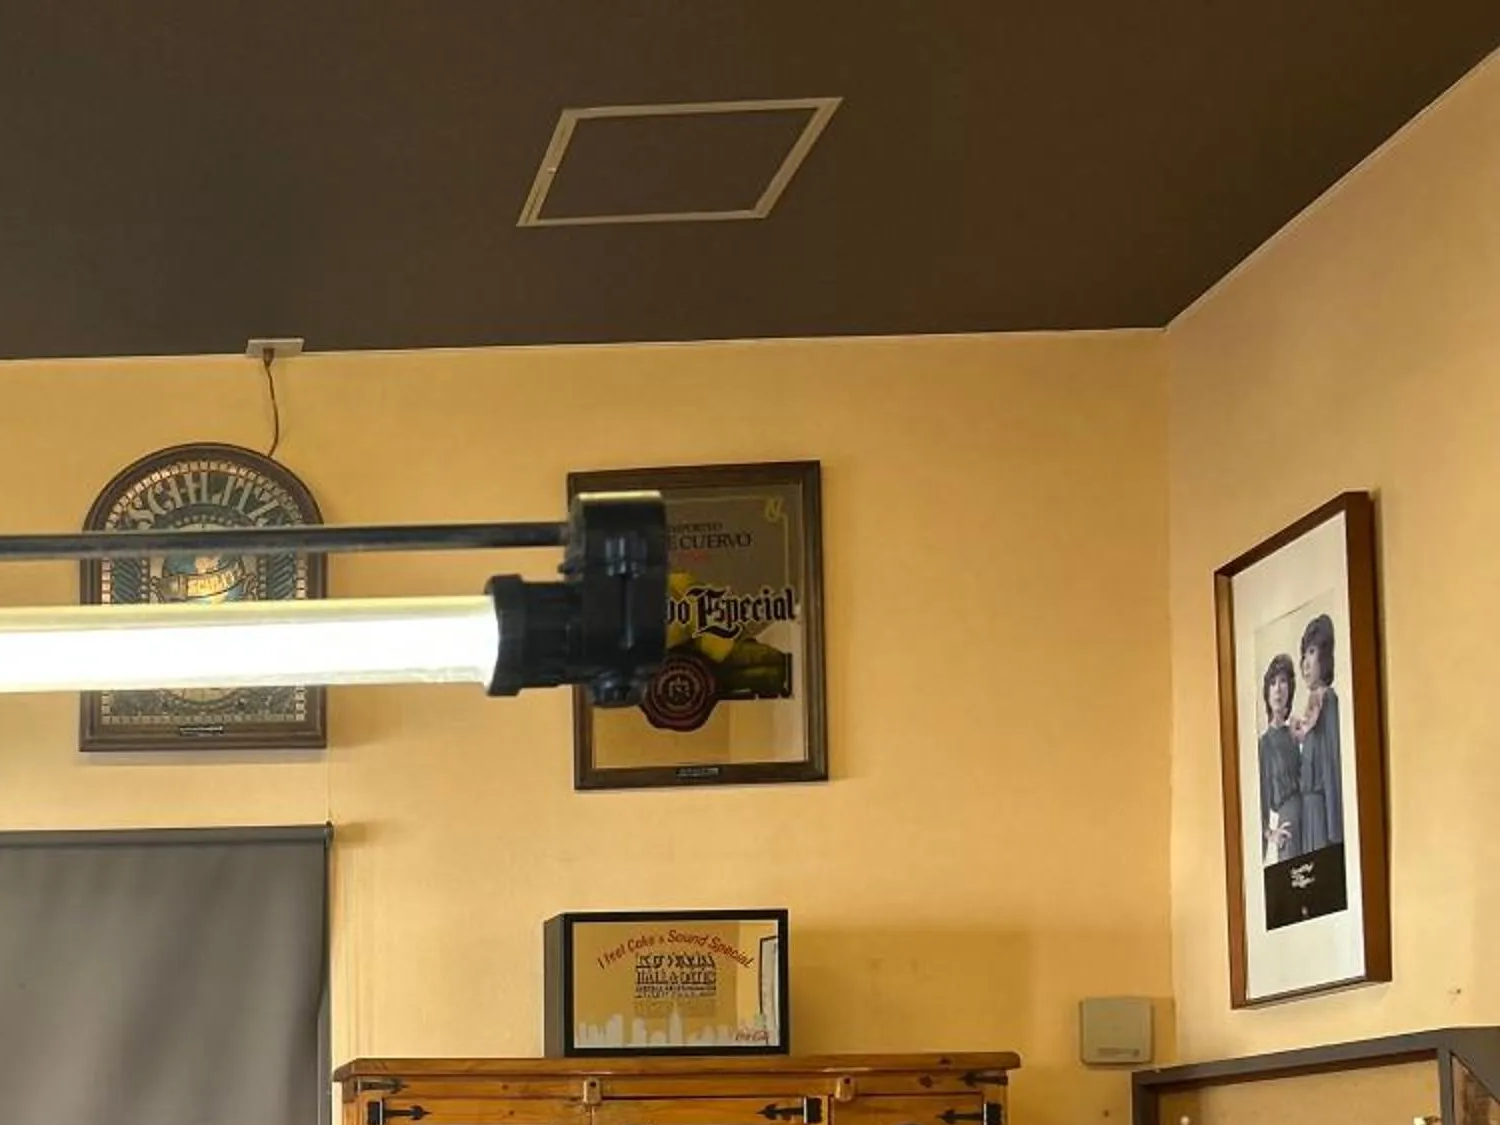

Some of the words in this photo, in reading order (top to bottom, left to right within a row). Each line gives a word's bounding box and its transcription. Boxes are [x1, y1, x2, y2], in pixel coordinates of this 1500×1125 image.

[127, 471, 281, 529] SCHLITZ
[680, 533, 752, 550] CUERVO
[686, 587, 796, 638] Especial
[668, 929, 708, 946] Sound
[708, 936, 755, 968] Special
